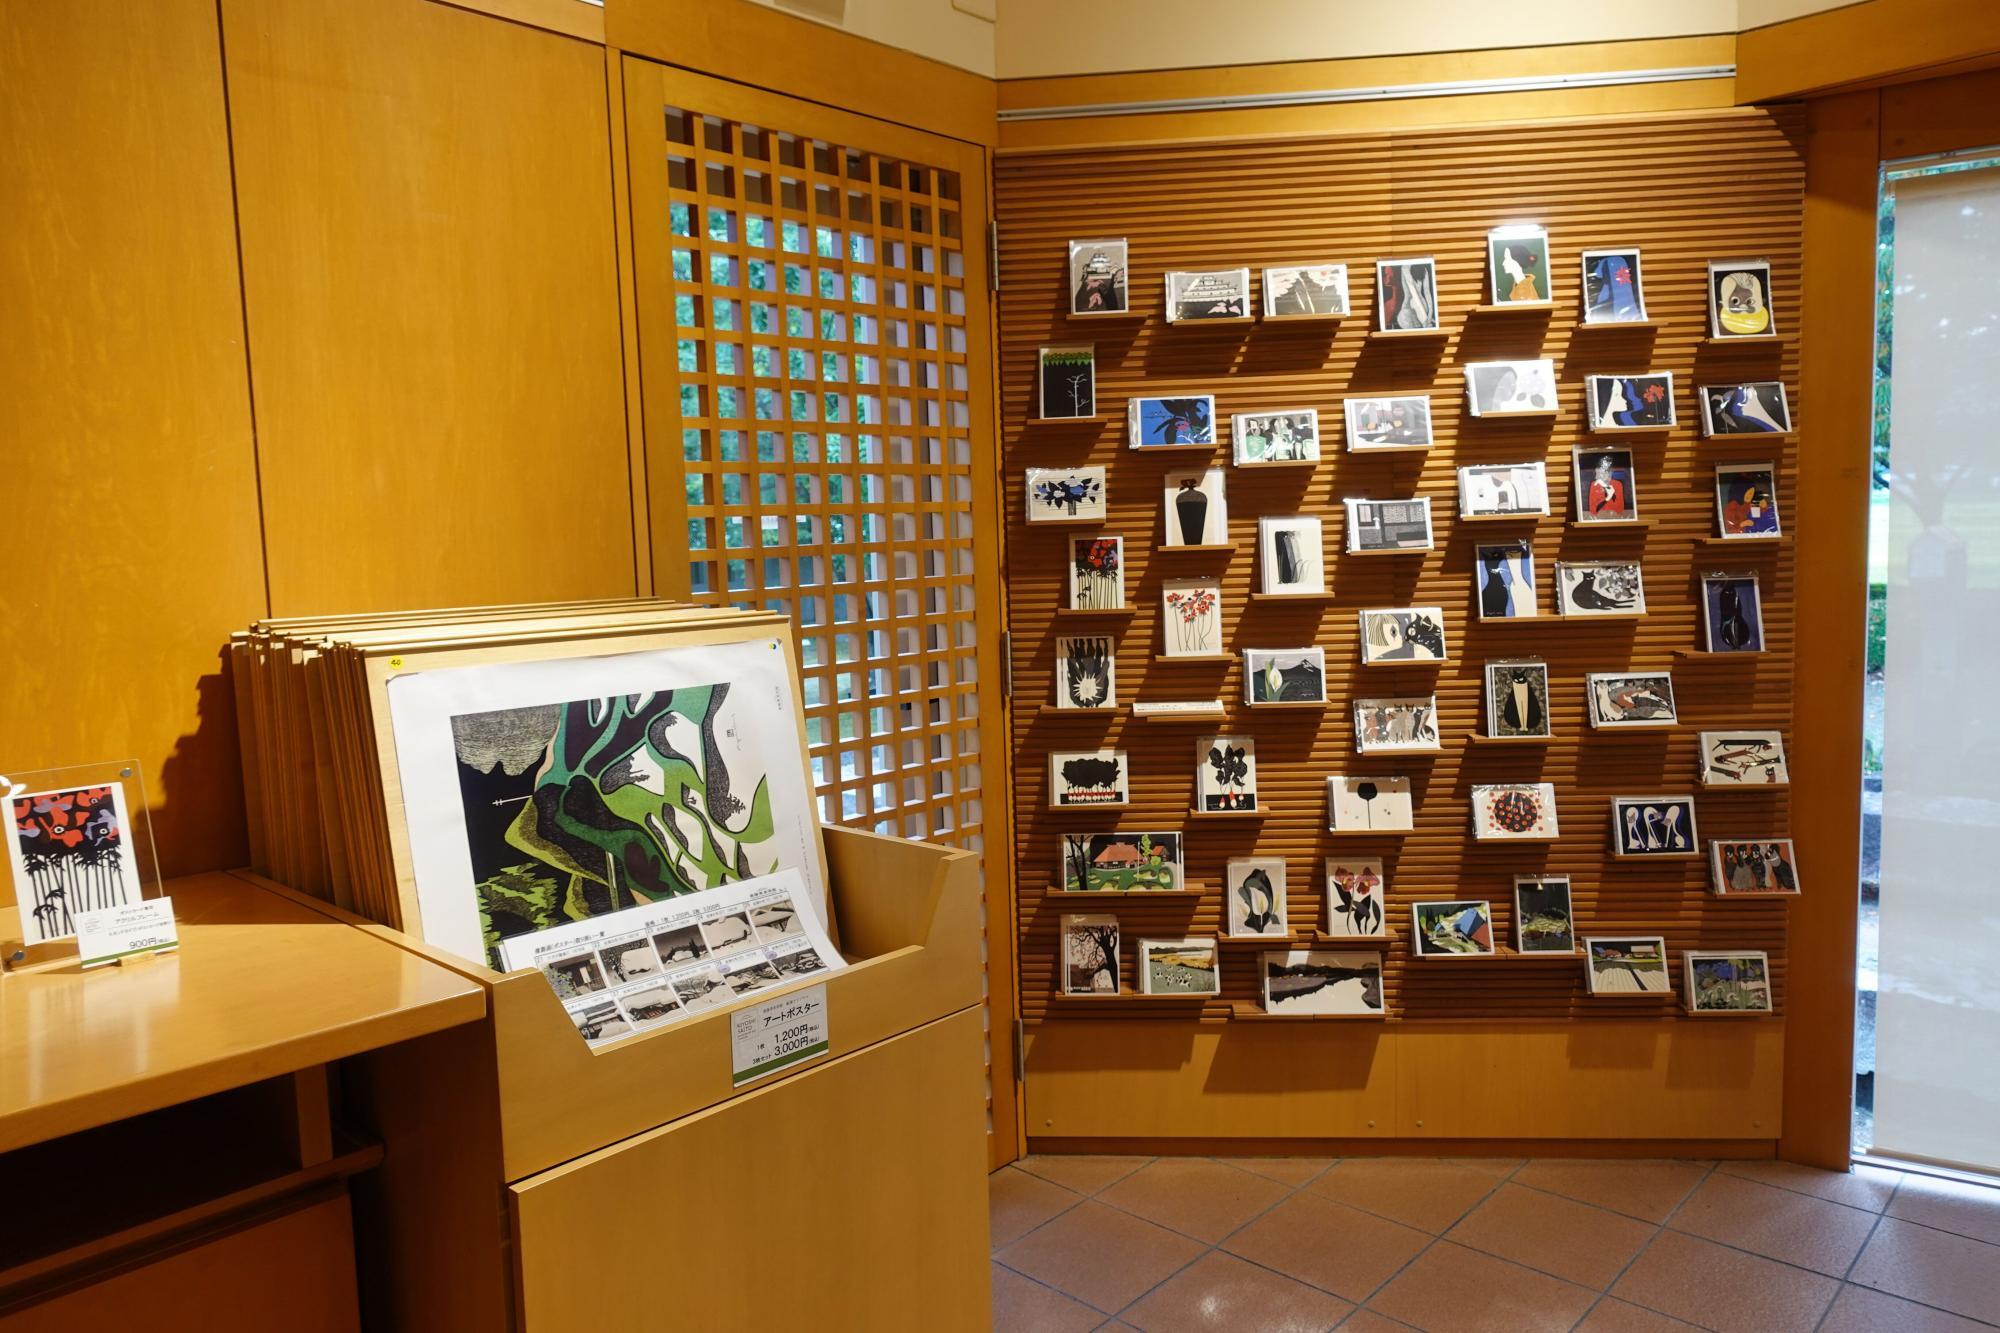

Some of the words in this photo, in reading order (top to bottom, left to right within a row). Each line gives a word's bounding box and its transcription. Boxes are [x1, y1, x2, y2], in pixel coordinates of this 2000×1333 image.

[763, 1002, 820, 1028] アートポスター
